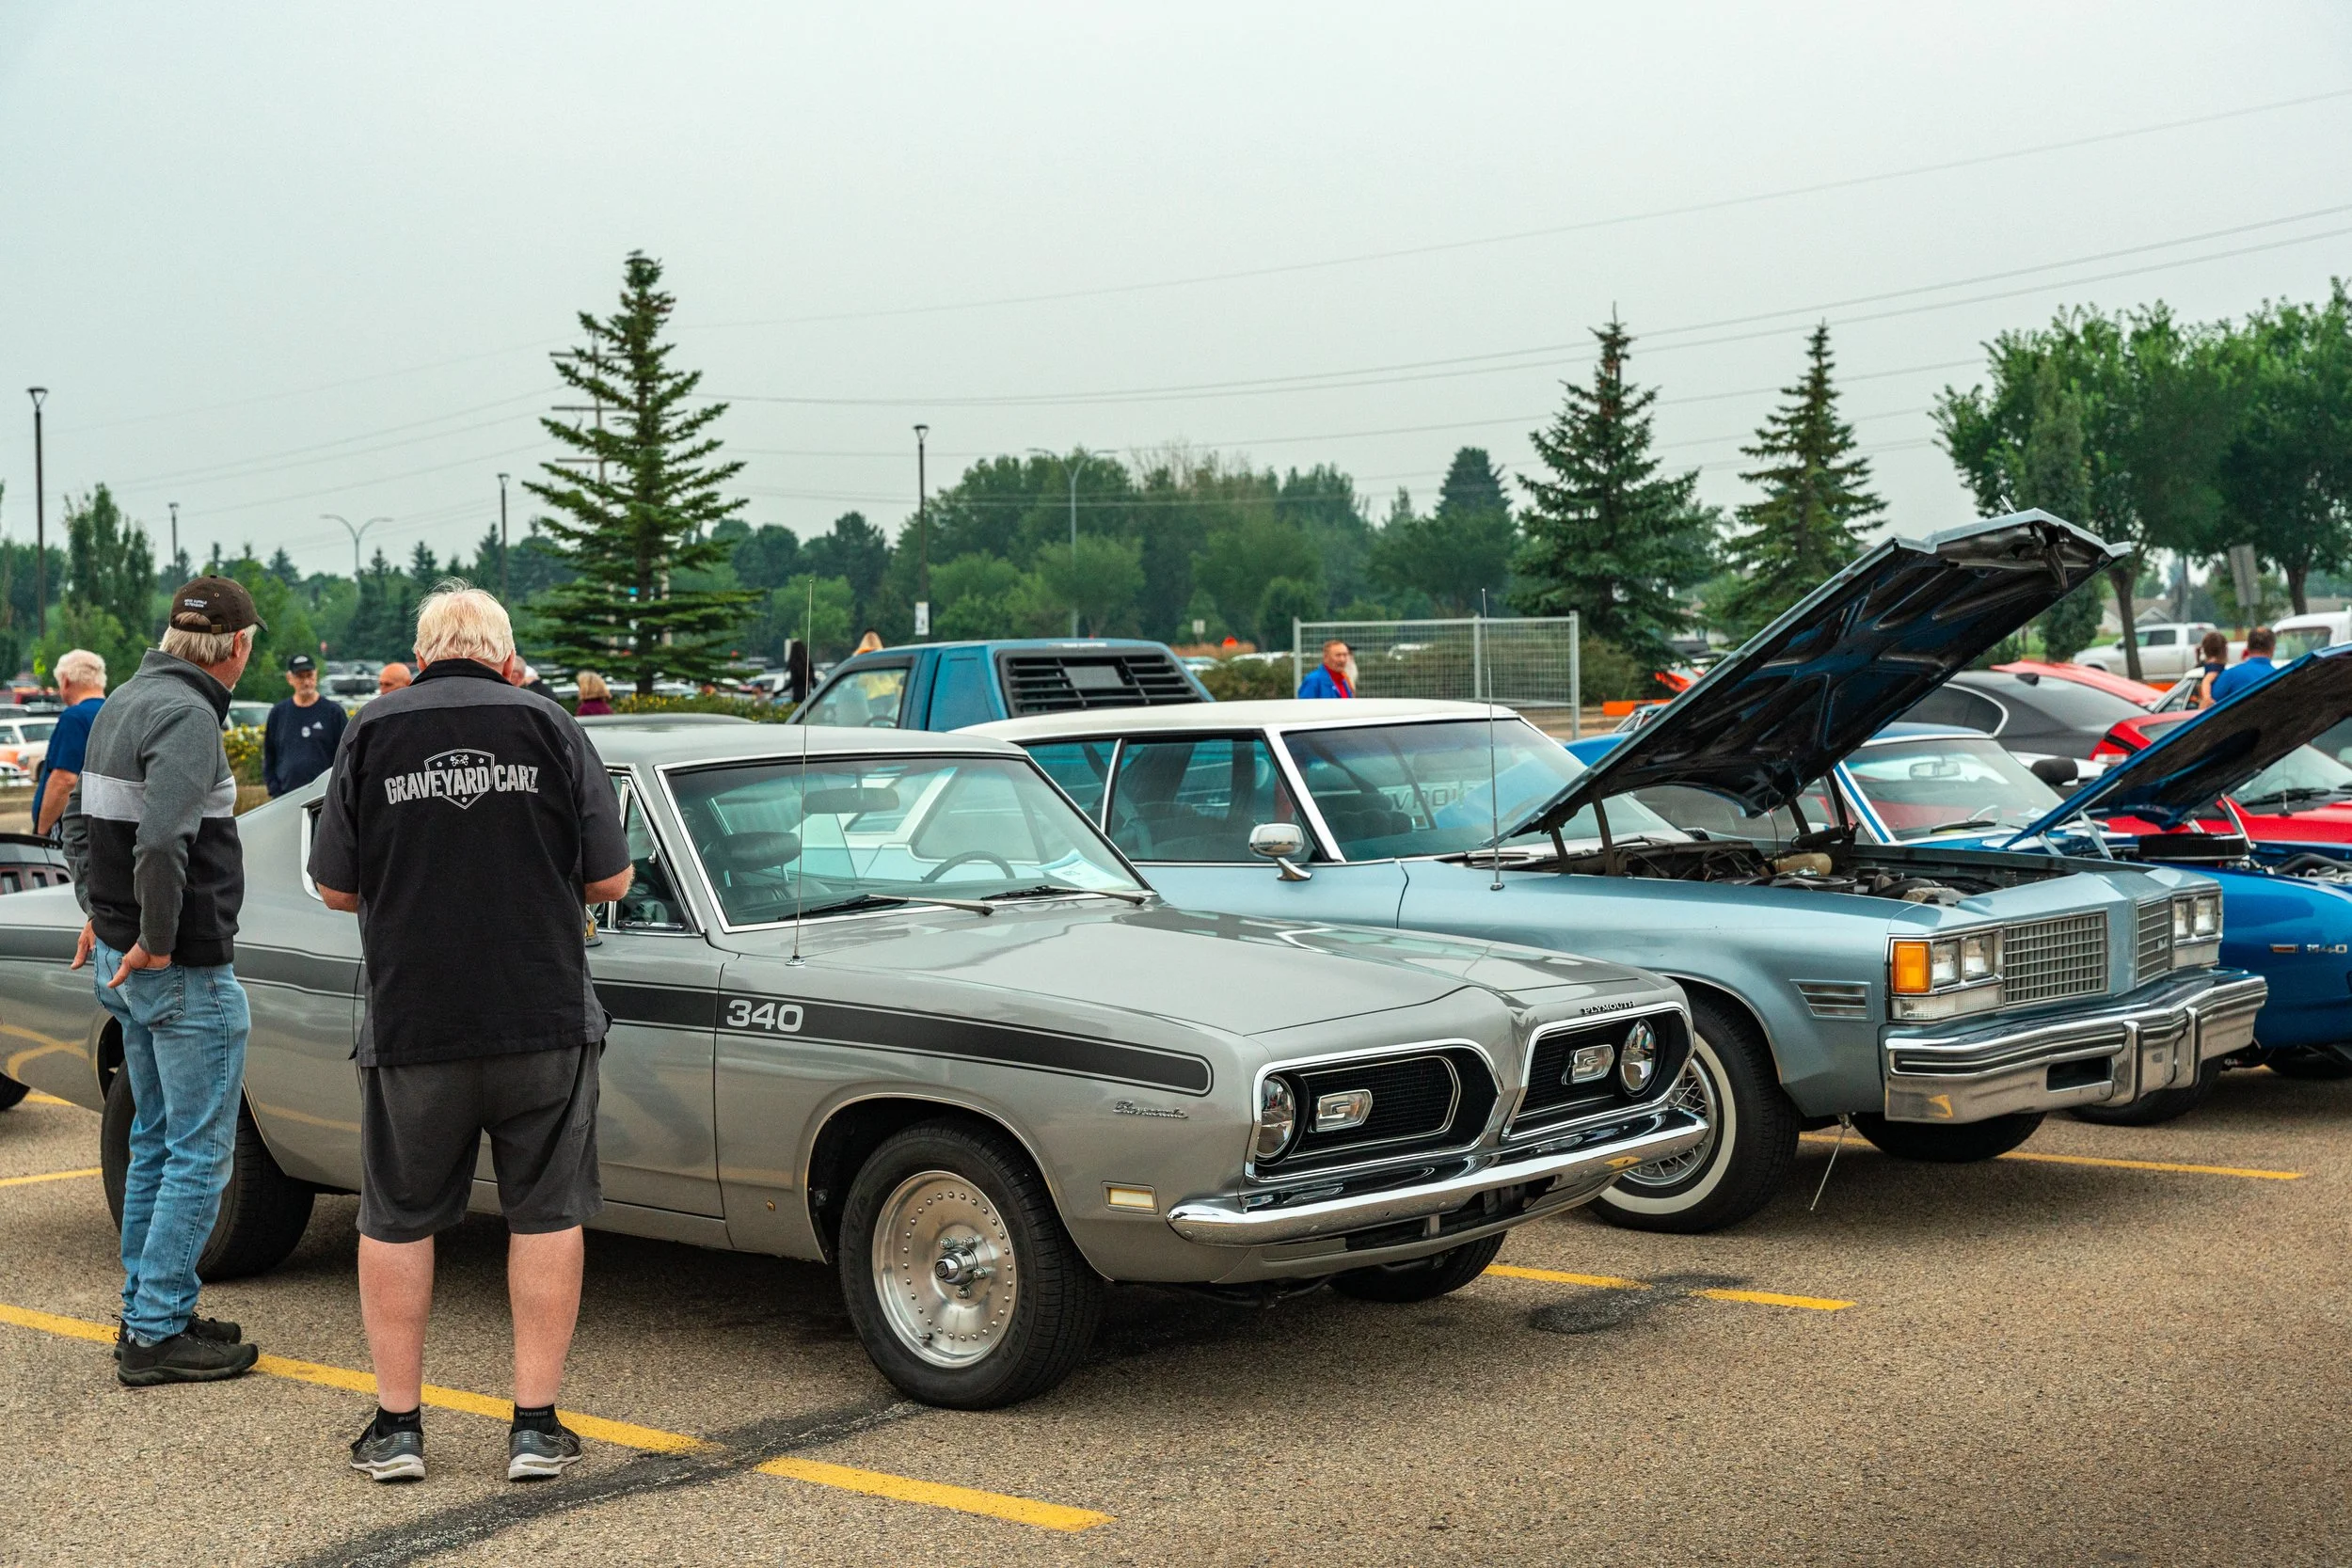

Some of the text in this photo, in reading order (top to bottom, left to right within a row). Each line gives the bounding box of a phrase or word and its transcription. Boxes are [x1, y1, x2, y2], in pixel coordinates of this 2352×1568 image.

[384, 764, 539, 805] GRAVEYARD CARZ
[726, 999, 804, 1033] 340
[1581, 1000, 1636, 1015] PLYMOUTH
